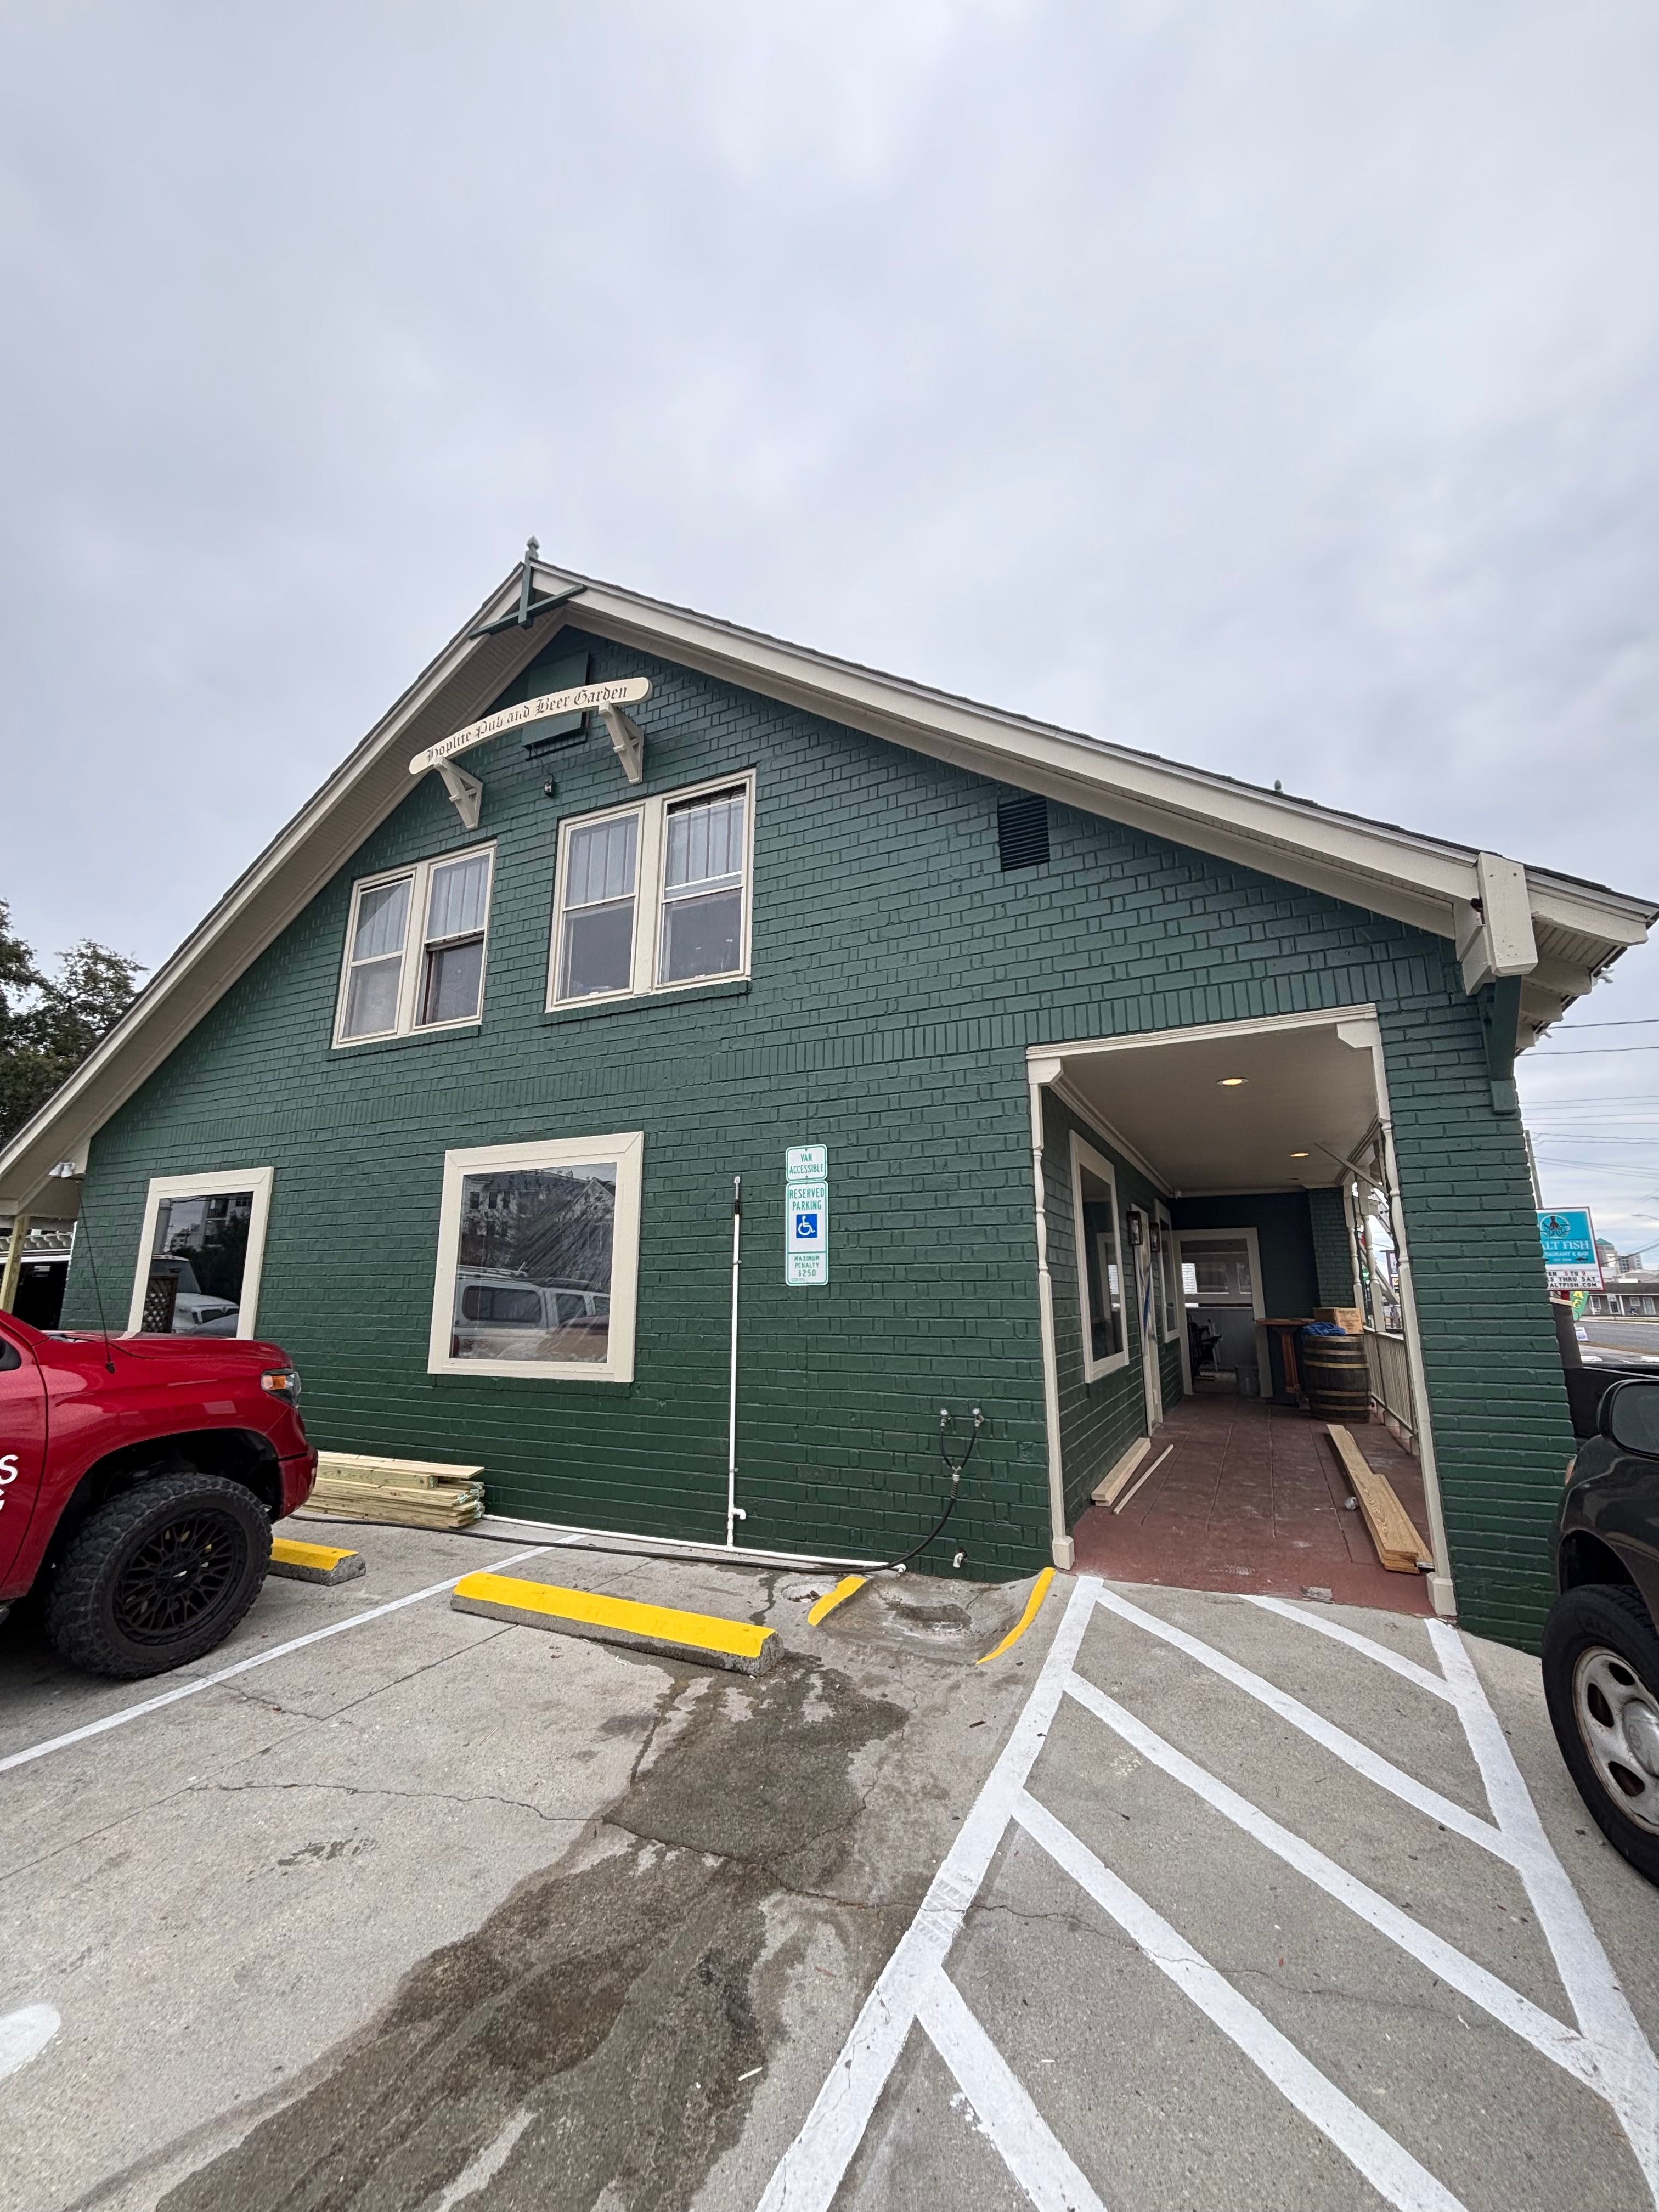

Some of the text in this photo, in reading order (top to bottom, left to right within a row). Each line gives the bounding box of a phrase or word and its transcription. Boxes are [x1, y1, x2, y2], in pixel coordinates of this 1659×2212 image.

[427, 686, 628, 761] Hoplite Pub and Beer Garden
[800, 1153, 812, 1162] VAN
[789, 1164, 824, 1174] ACCESSIBLE
[789, 1188, 825, 1199] RESERVED
[792, 1200, 822, 1211] PARKING
[1562, 1240, 1589, 1250] FISH
